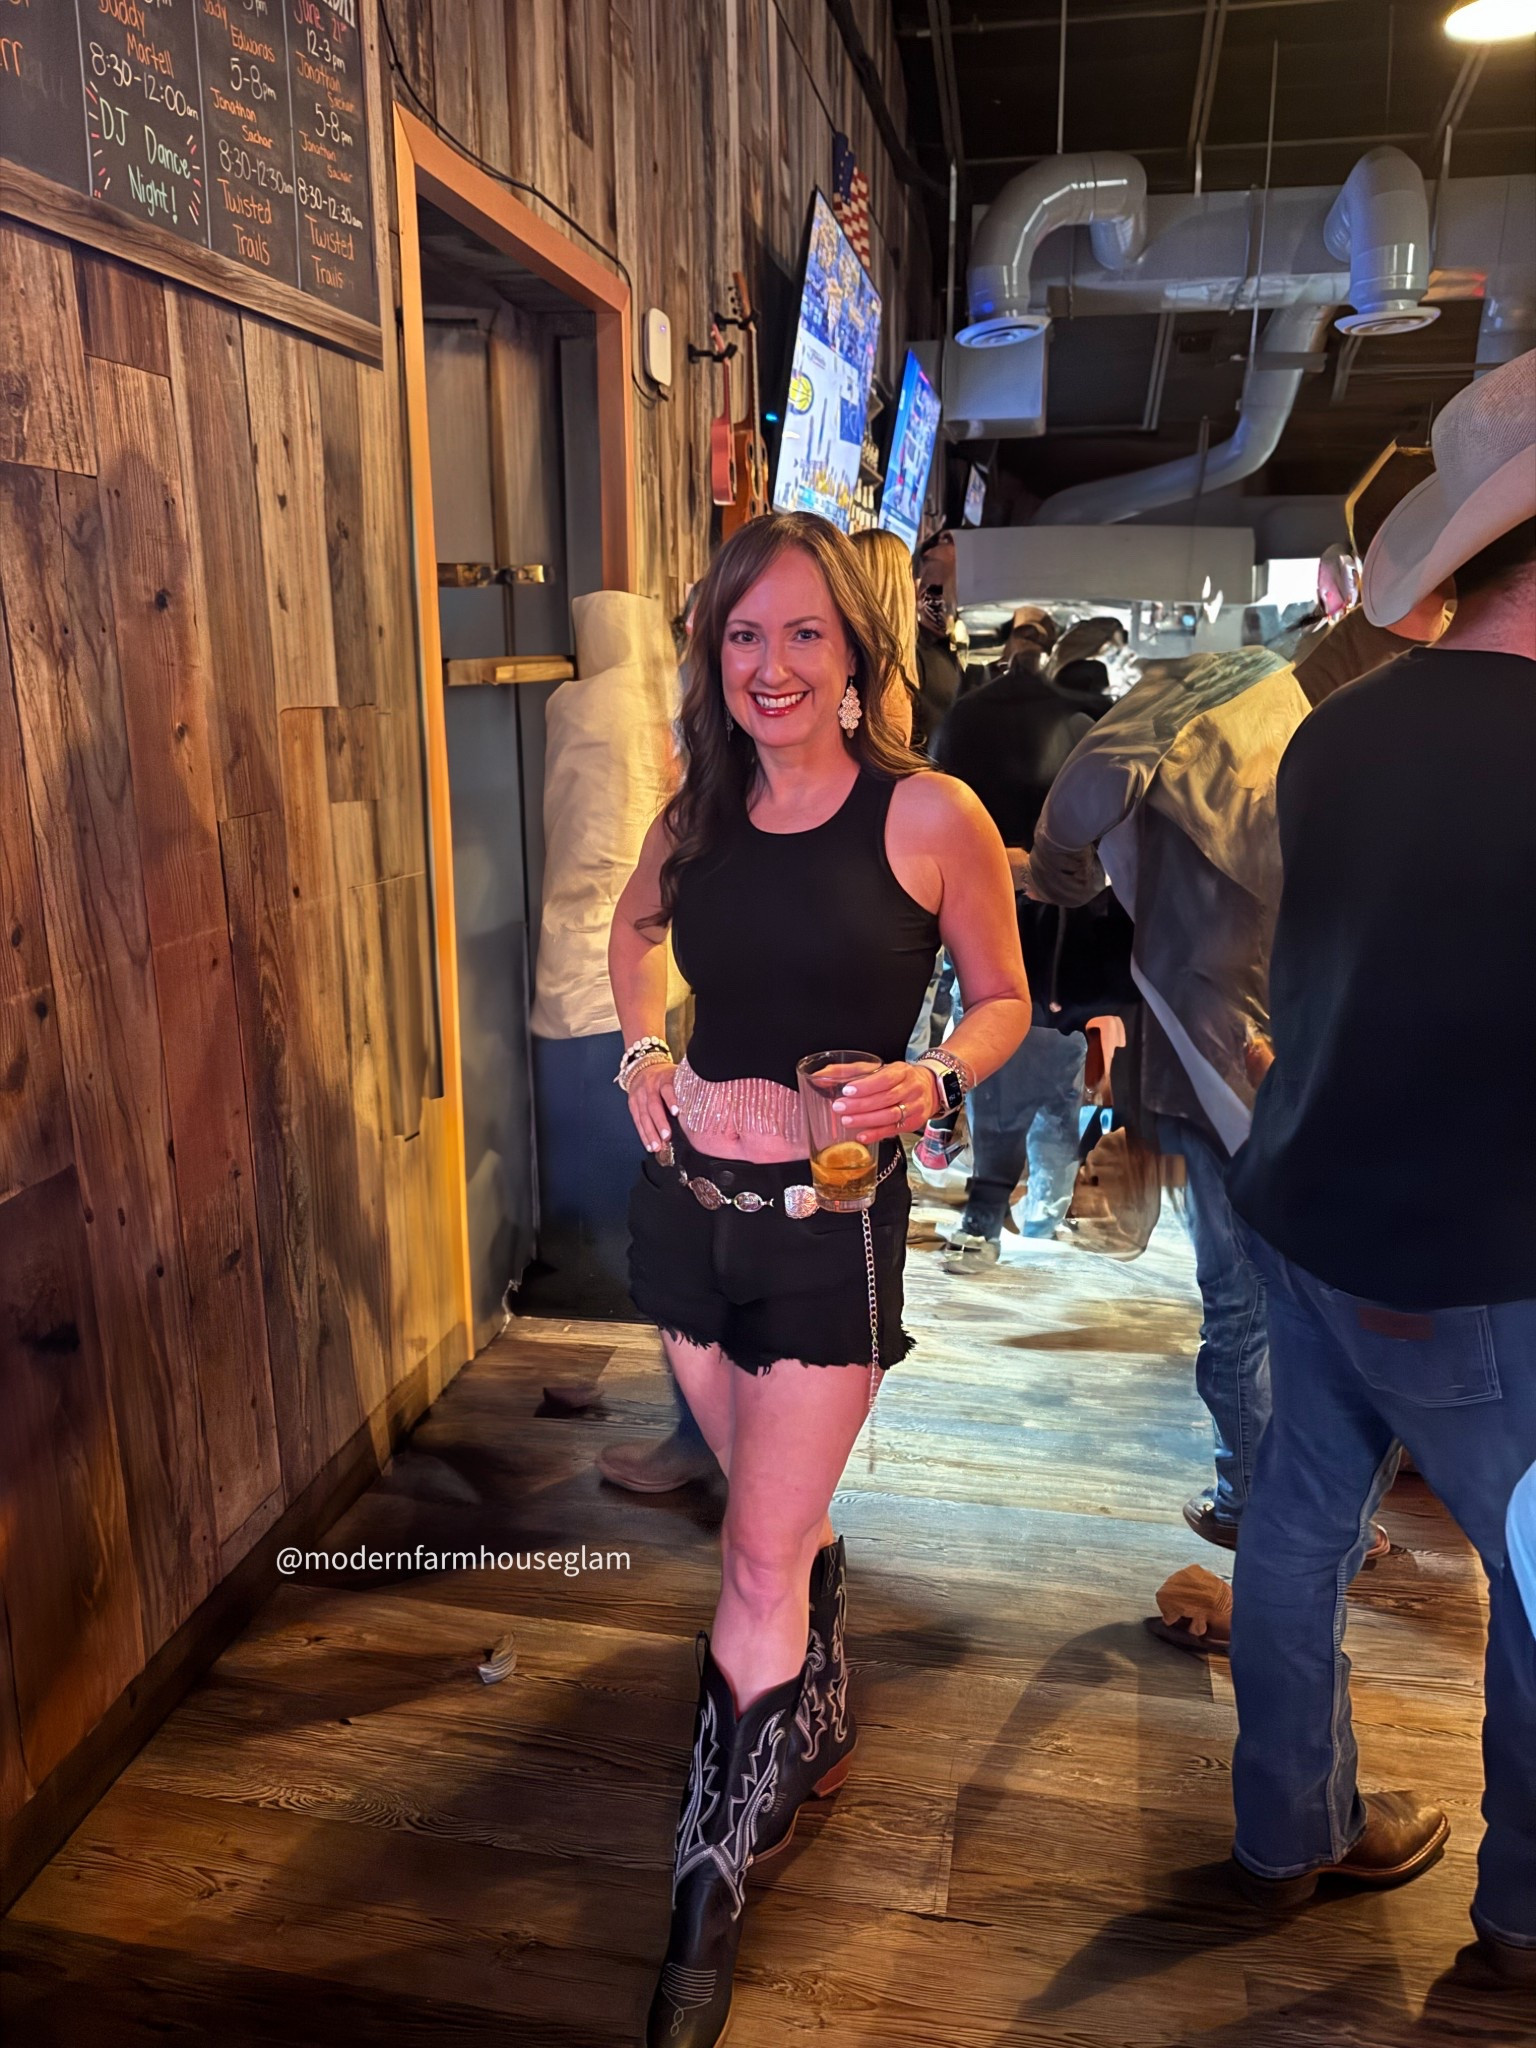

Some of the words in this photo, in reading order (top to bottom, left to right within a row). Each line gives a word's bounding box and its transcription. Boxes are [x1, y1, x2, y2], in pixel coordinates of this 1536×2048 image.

[126, 31, 174, 79] Martell
[210, 86, 257, 123] Jonathan
[100, 97, 130, 147] DJ
[144, 124, 191, 179] Dance
[127, 163, 178, 225] Night!
[217, 178, 273, 225] Twisted
[232, 223, 271, 266] Trails
[304, 214, 354, 261] Twisted
[311, 255, 343, 289] Trails
